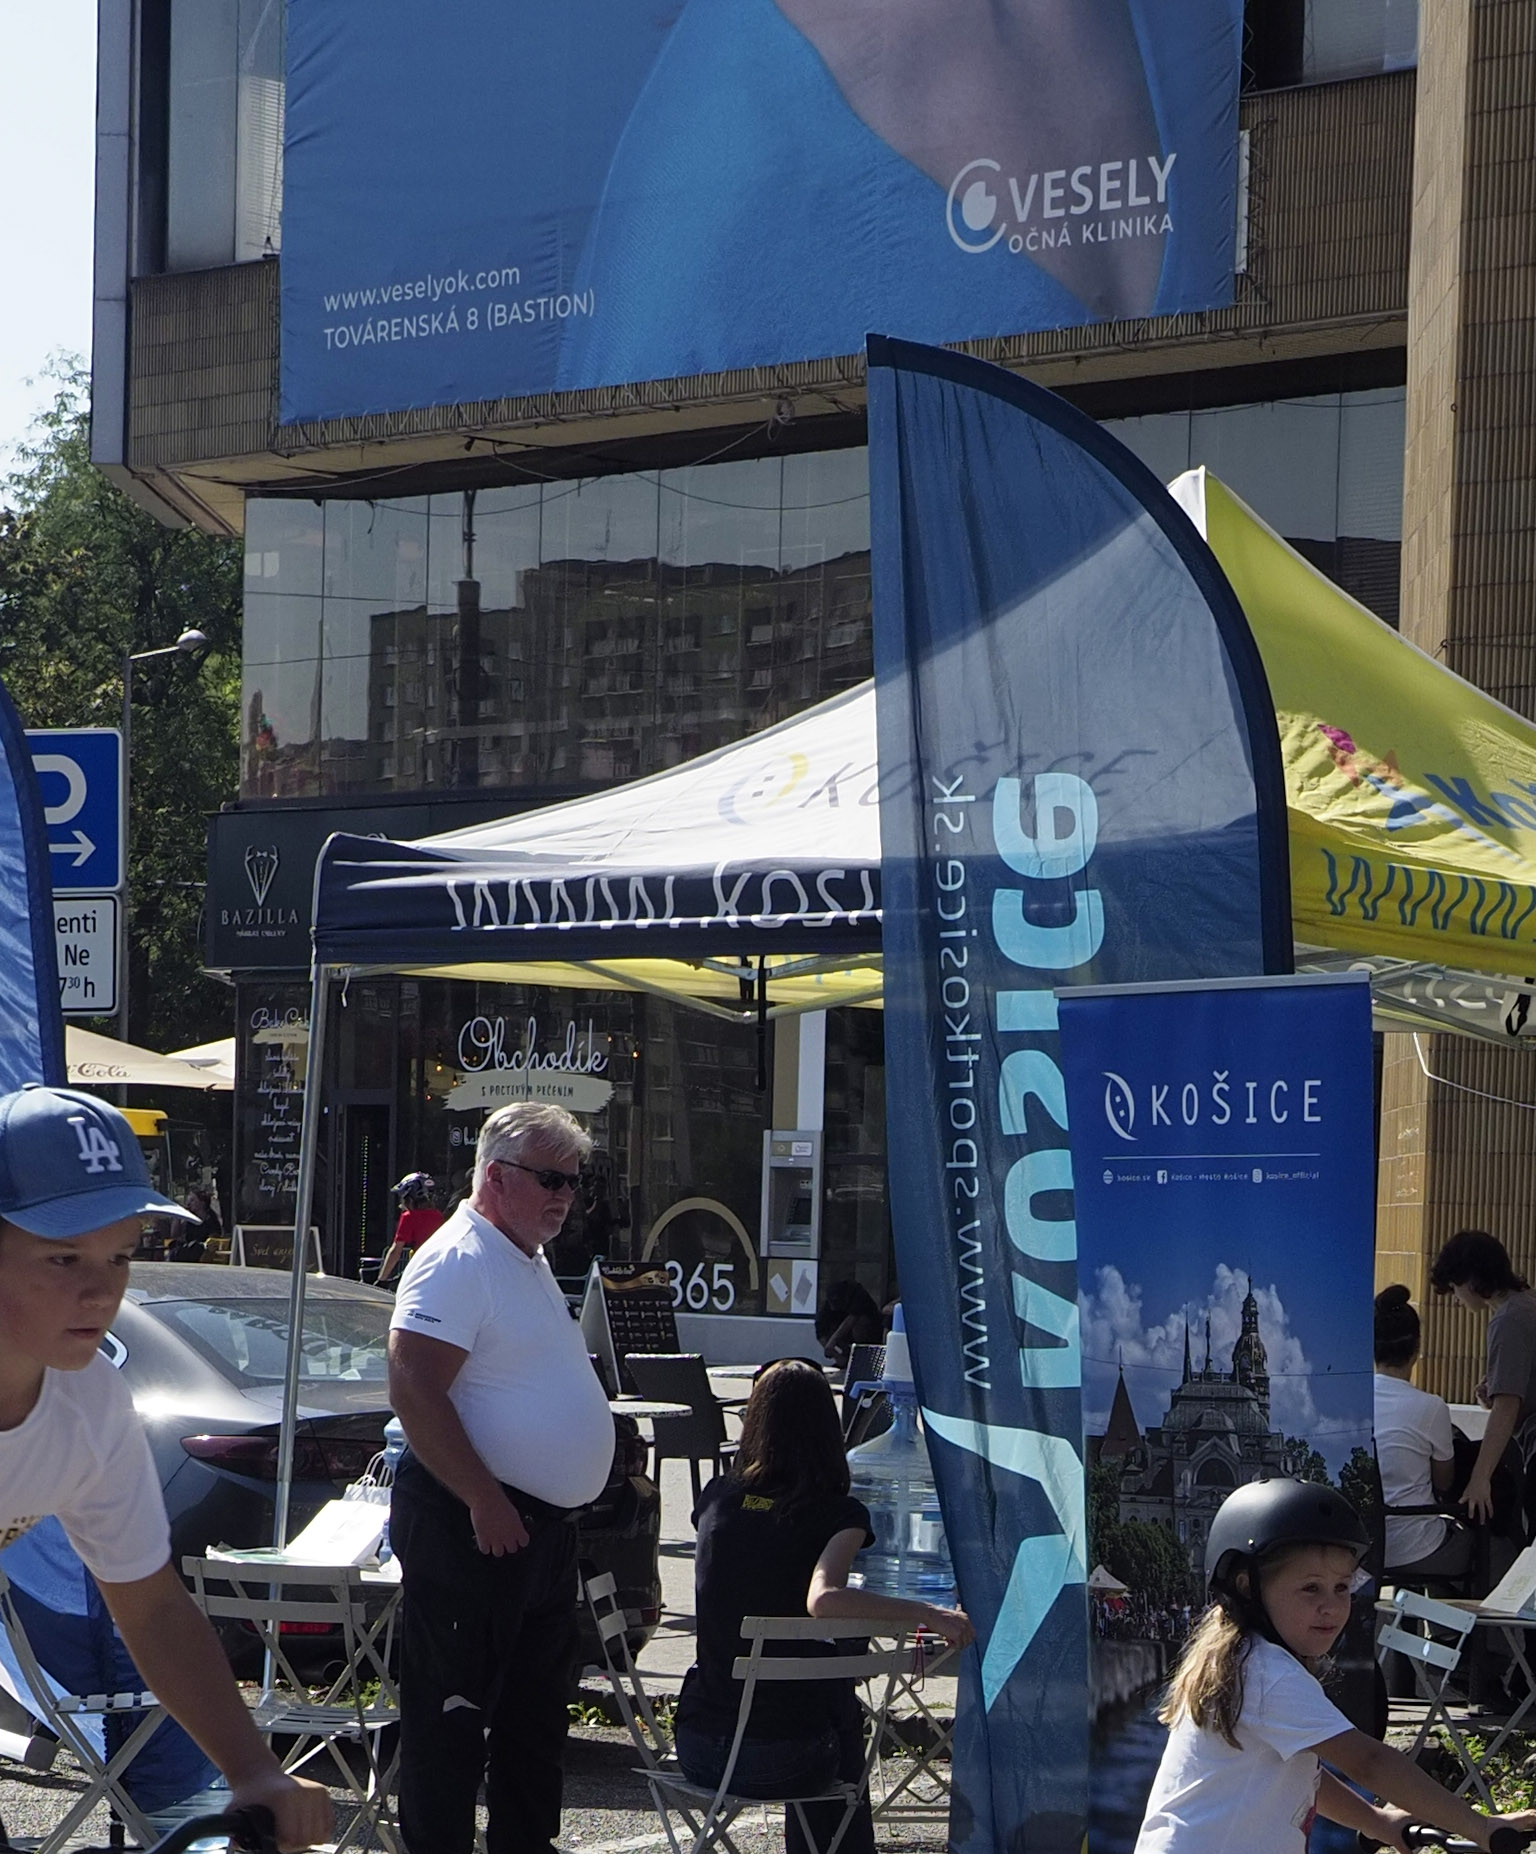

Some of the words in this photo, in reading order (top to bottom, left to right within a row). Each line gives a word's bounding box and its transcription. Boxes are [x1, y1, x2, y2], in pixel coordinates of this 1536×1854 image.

[1007, 153, 1178, 222] VESELY
[1008, 220, 1073, 254] OČNÁ
[1080, 213, 1175, 245] KLINIKA
[323, 264, 521, 313] www.veselyok.com
[323, 306, 461, 351] TOVÁRENSKÁ
[466, 308, 480, 332] 8
[485, 288, 596, 334] (BASTION)
[221, 908, 299, 926] BAZILLA
[84, 976, 95, 998] h
[458, 1015, 609, 1074] Obchodík
[489, 1083, 533, 1096] POCTIVÝM
[1151, 1069, 1322, 1126] KOŠICE
[66, 1115, 124, 1175] LA
[665, 1259, 736, 1312] 365
